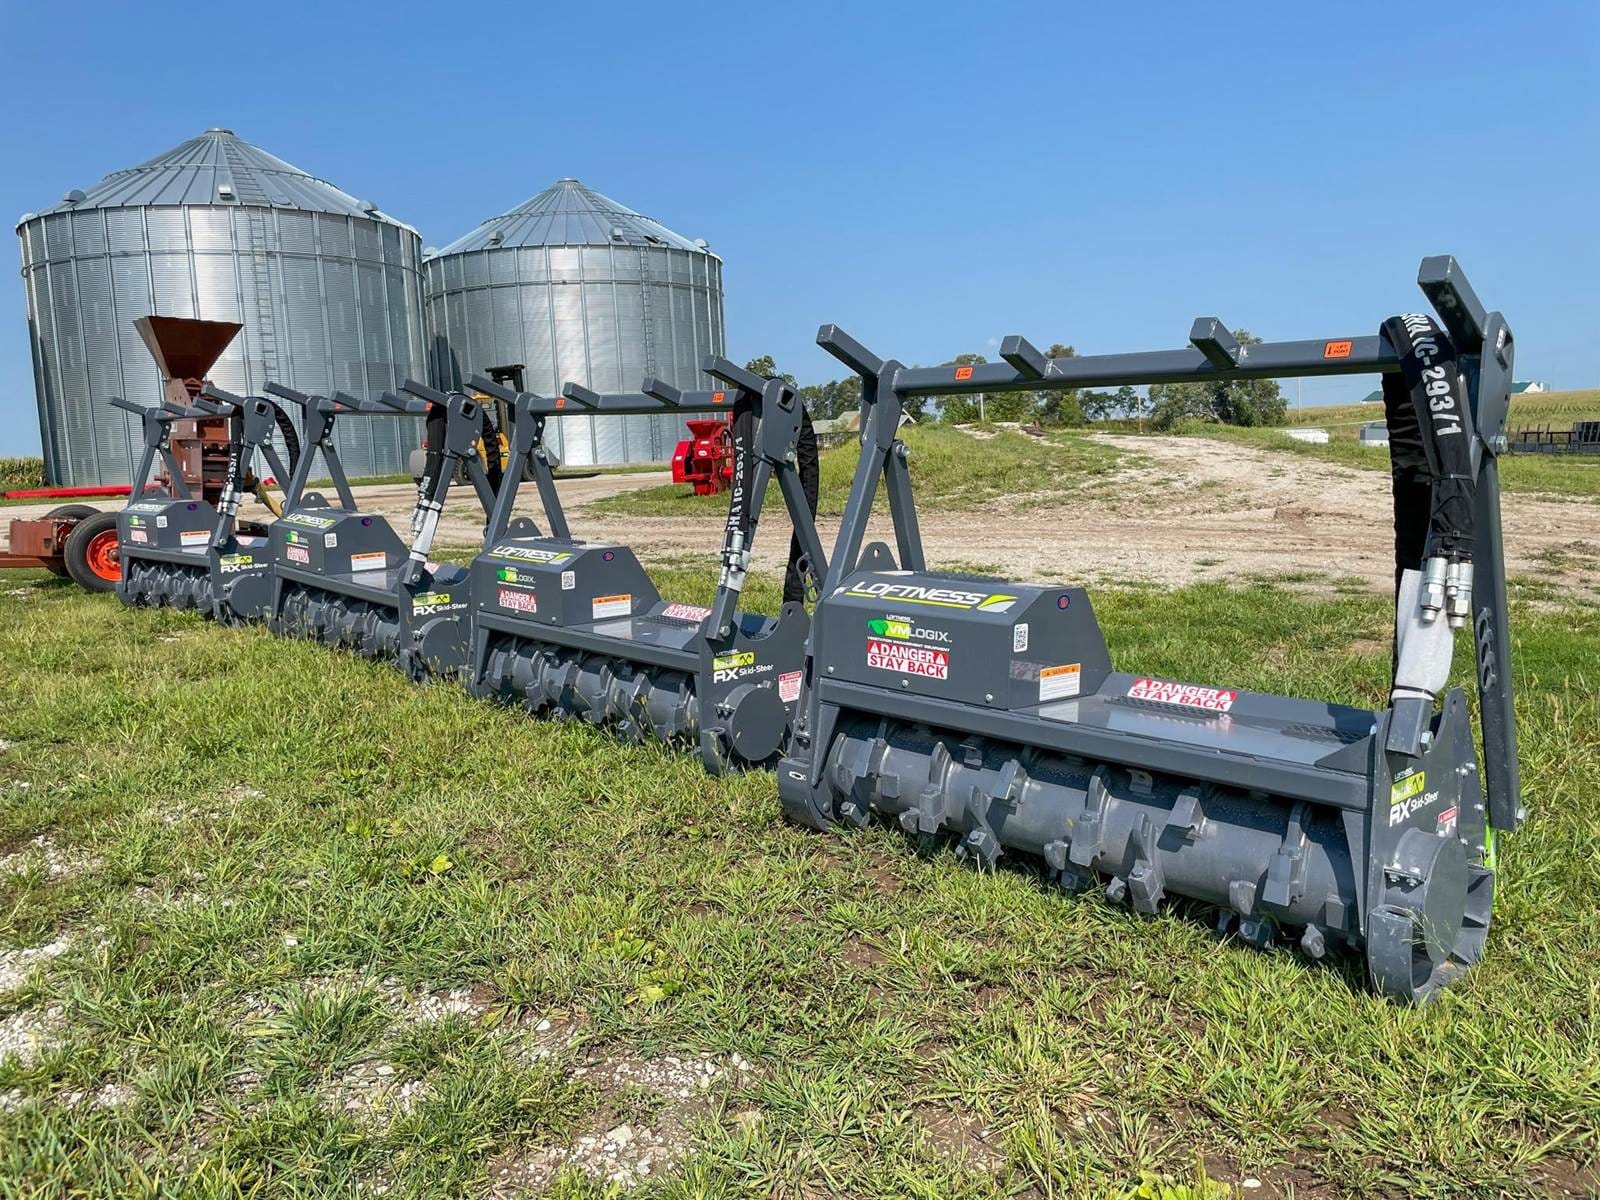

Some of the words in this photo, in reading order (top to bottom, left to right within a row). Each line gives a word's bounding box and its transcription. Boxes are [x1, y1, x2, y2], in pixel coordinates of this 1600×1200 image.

[1411, 337, 1462, 436] IC-293/1
[852, 581, 988, 605] LOFTNESS
[880, 643, 934, 664] DANGER
[870, 654, 904, 669] STAY
[908, 661, 945, 678] BACK
[1132, 688, 1176, 701] STAY
[1180, 693, 1228, 710] BACK
[1150, 681, 1219, 700] DANGER
